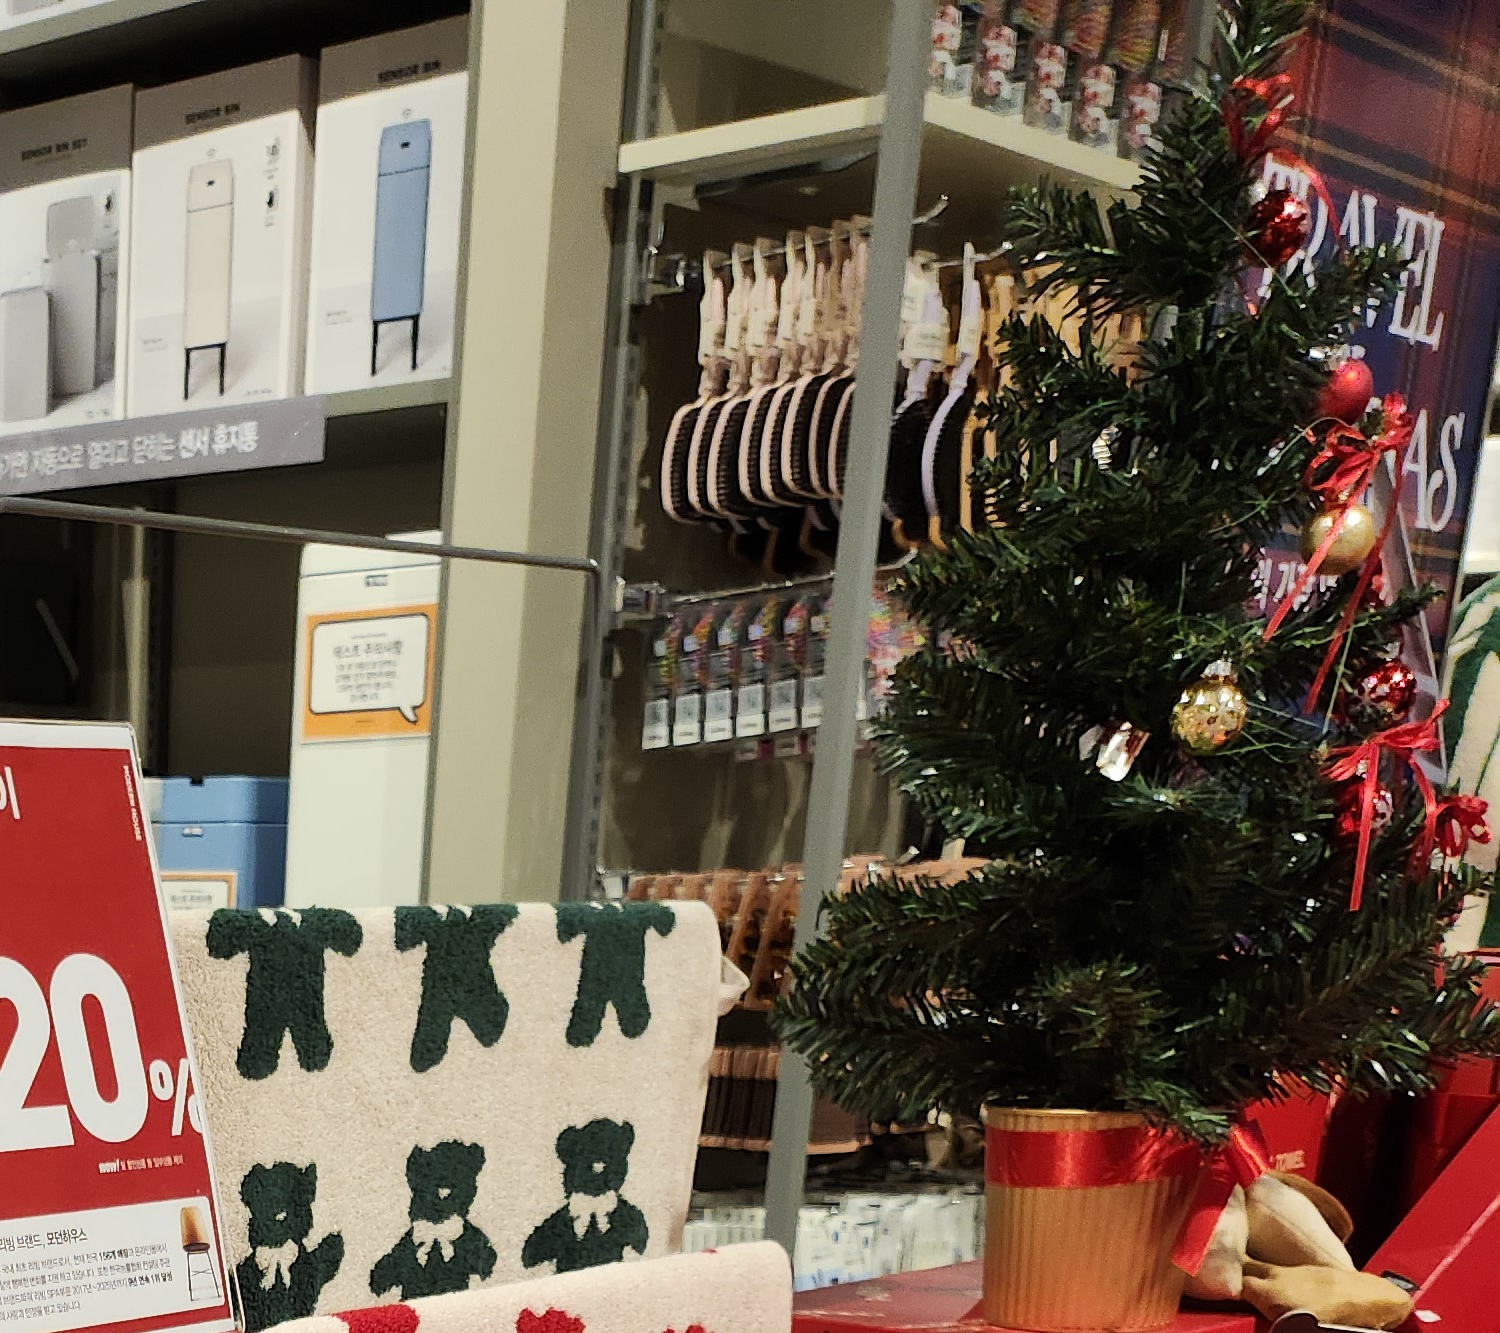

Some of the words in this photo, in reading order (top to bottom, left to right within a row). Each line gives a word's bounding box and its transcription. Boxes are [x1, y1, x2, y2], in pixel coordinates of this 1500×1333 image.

[179, 426, 210, 459] 센서
[213, 421, 258, 454] 휴지통
[16, 1234, 46, 1249] 브랜드,
[47, 1228, 88, 1246] 모던하우스
